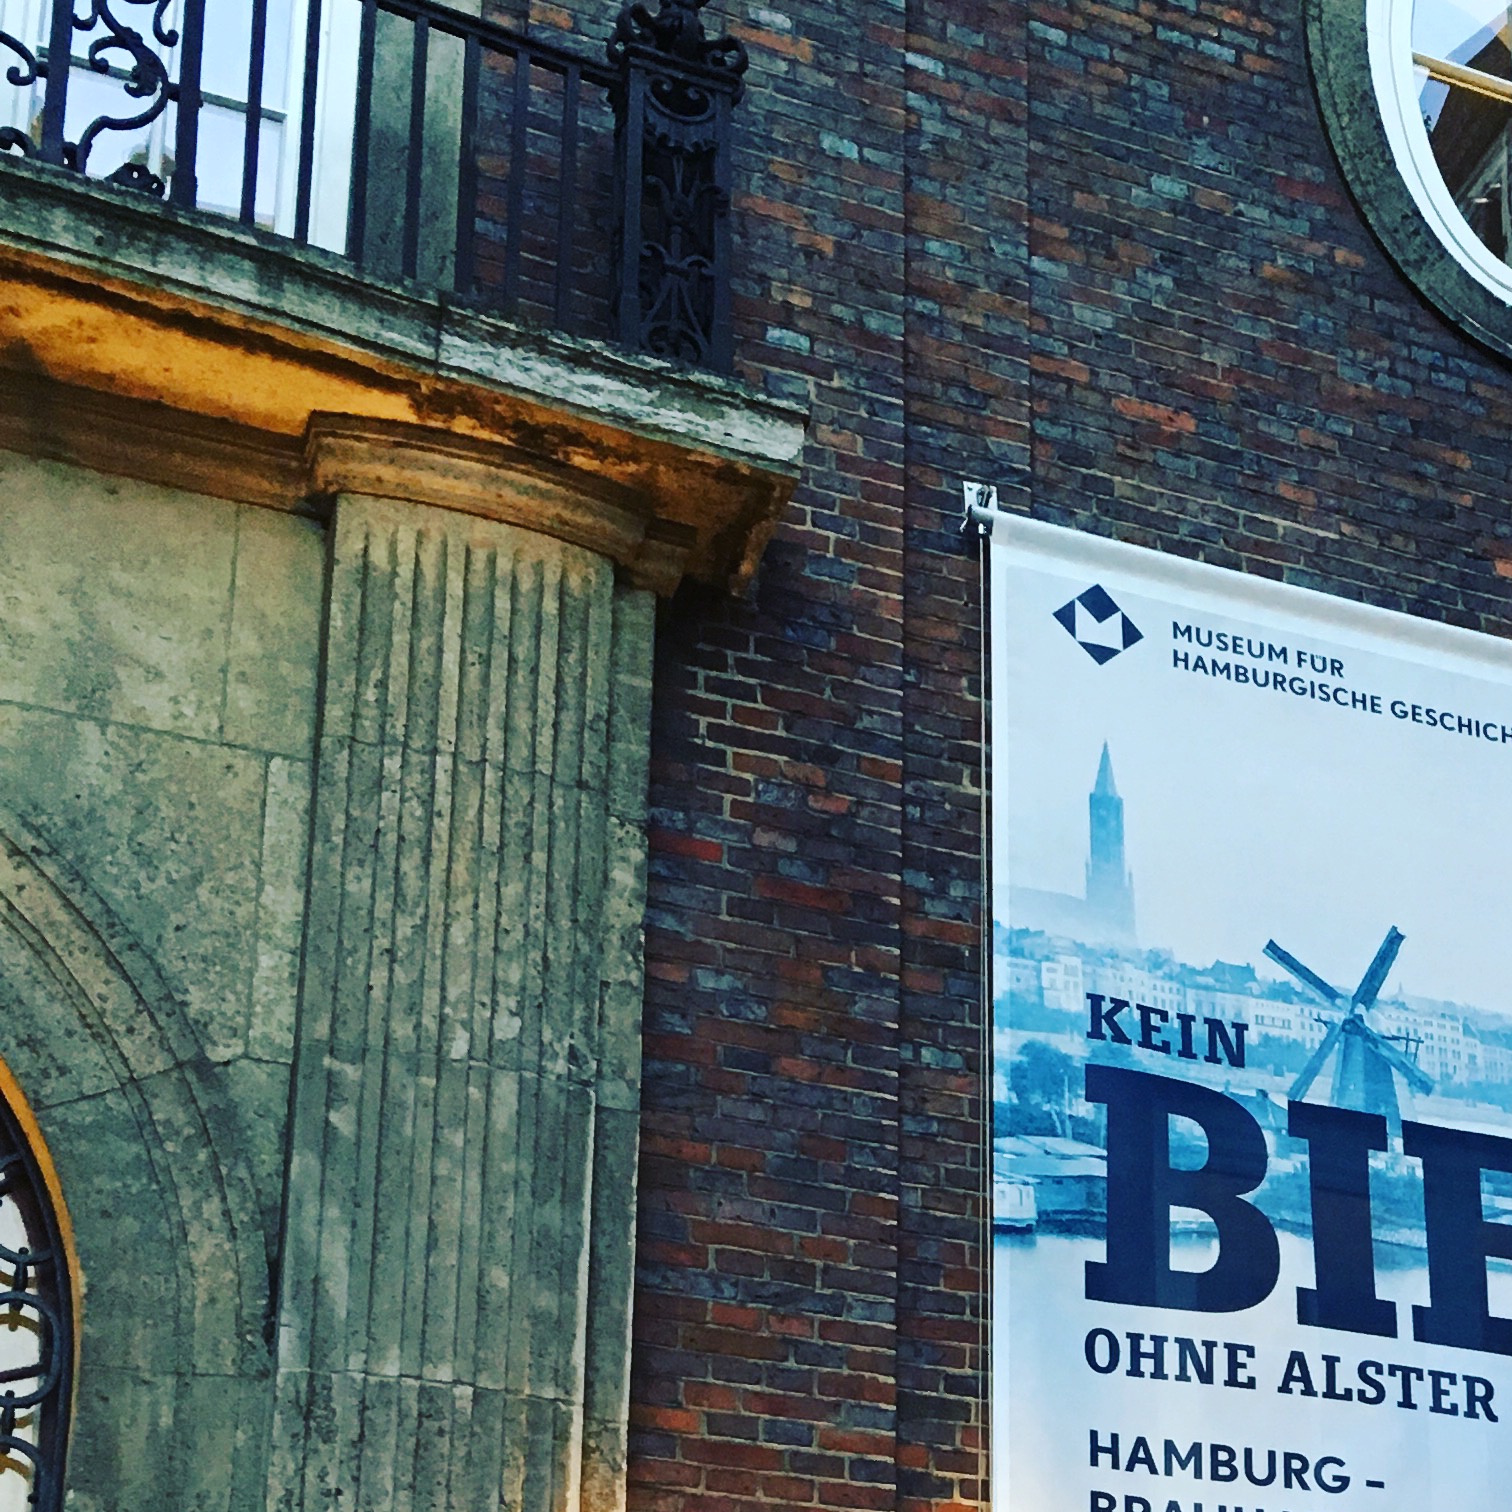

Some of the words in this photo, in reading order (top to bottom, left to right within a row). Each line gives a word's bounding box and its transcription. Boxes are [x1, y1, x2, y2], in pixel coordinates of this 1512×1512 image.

[1172, 620, 1288, 665] MUSEUM
[1296, 650, 1345, 679] FÜR
[1172, 649, 1383, 715] HAMBURGISCHE
[1086, 992, 1249, 1068] KEIN
[1084, 1327, 1257, 1390] OHNE
[1277, 1350, 1499, 1423] ALSTER
[1089, 1429, 1351, 1494] HAMBURG
